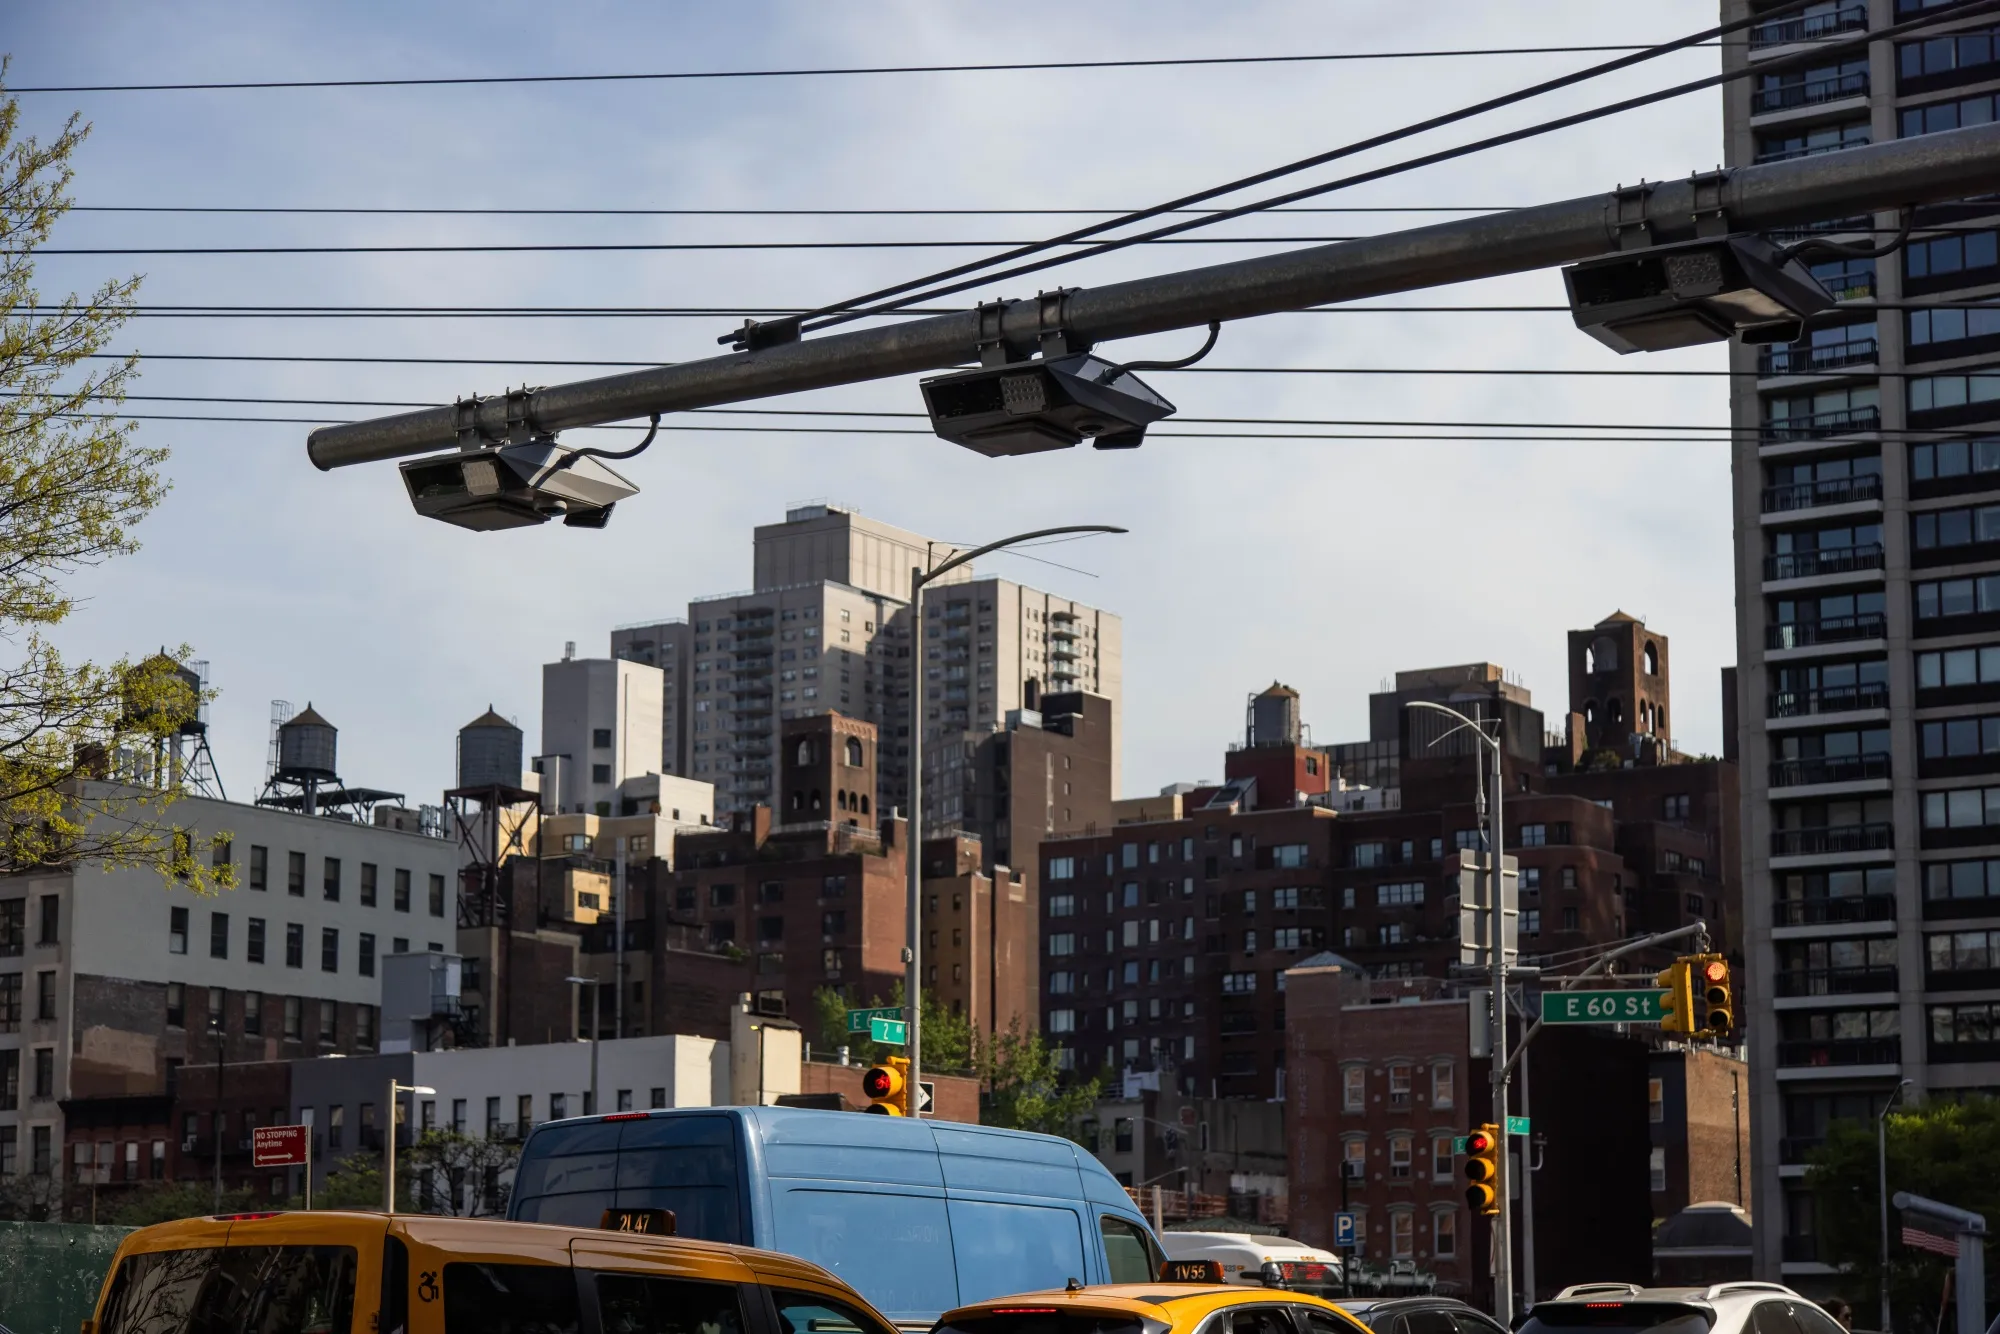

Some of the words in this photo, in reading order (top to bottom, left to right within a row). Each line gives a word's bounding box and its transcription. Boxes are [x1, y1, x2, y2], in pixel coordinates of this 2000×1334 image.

[1567, 998, 1579, 1016] E
[1587, 997, 1616, 1016] 60
[1625, 997, 1650, 1015] St
[853, 1013, 861, 1029] E
[887, 1010, 896, 1020] ST
[883, 1023, 889, 1040] 2
[1510, 1119, 1516, 1132] 2
[256, 1132, 266, 1140] NO
[266, 1130, 298, 1139] STOPPING
[257, 1140, 283, 1149] Anytime
[1338, 1216, 1352, 1237] P
[1175, 1265, 1206, 1280] 1V55
